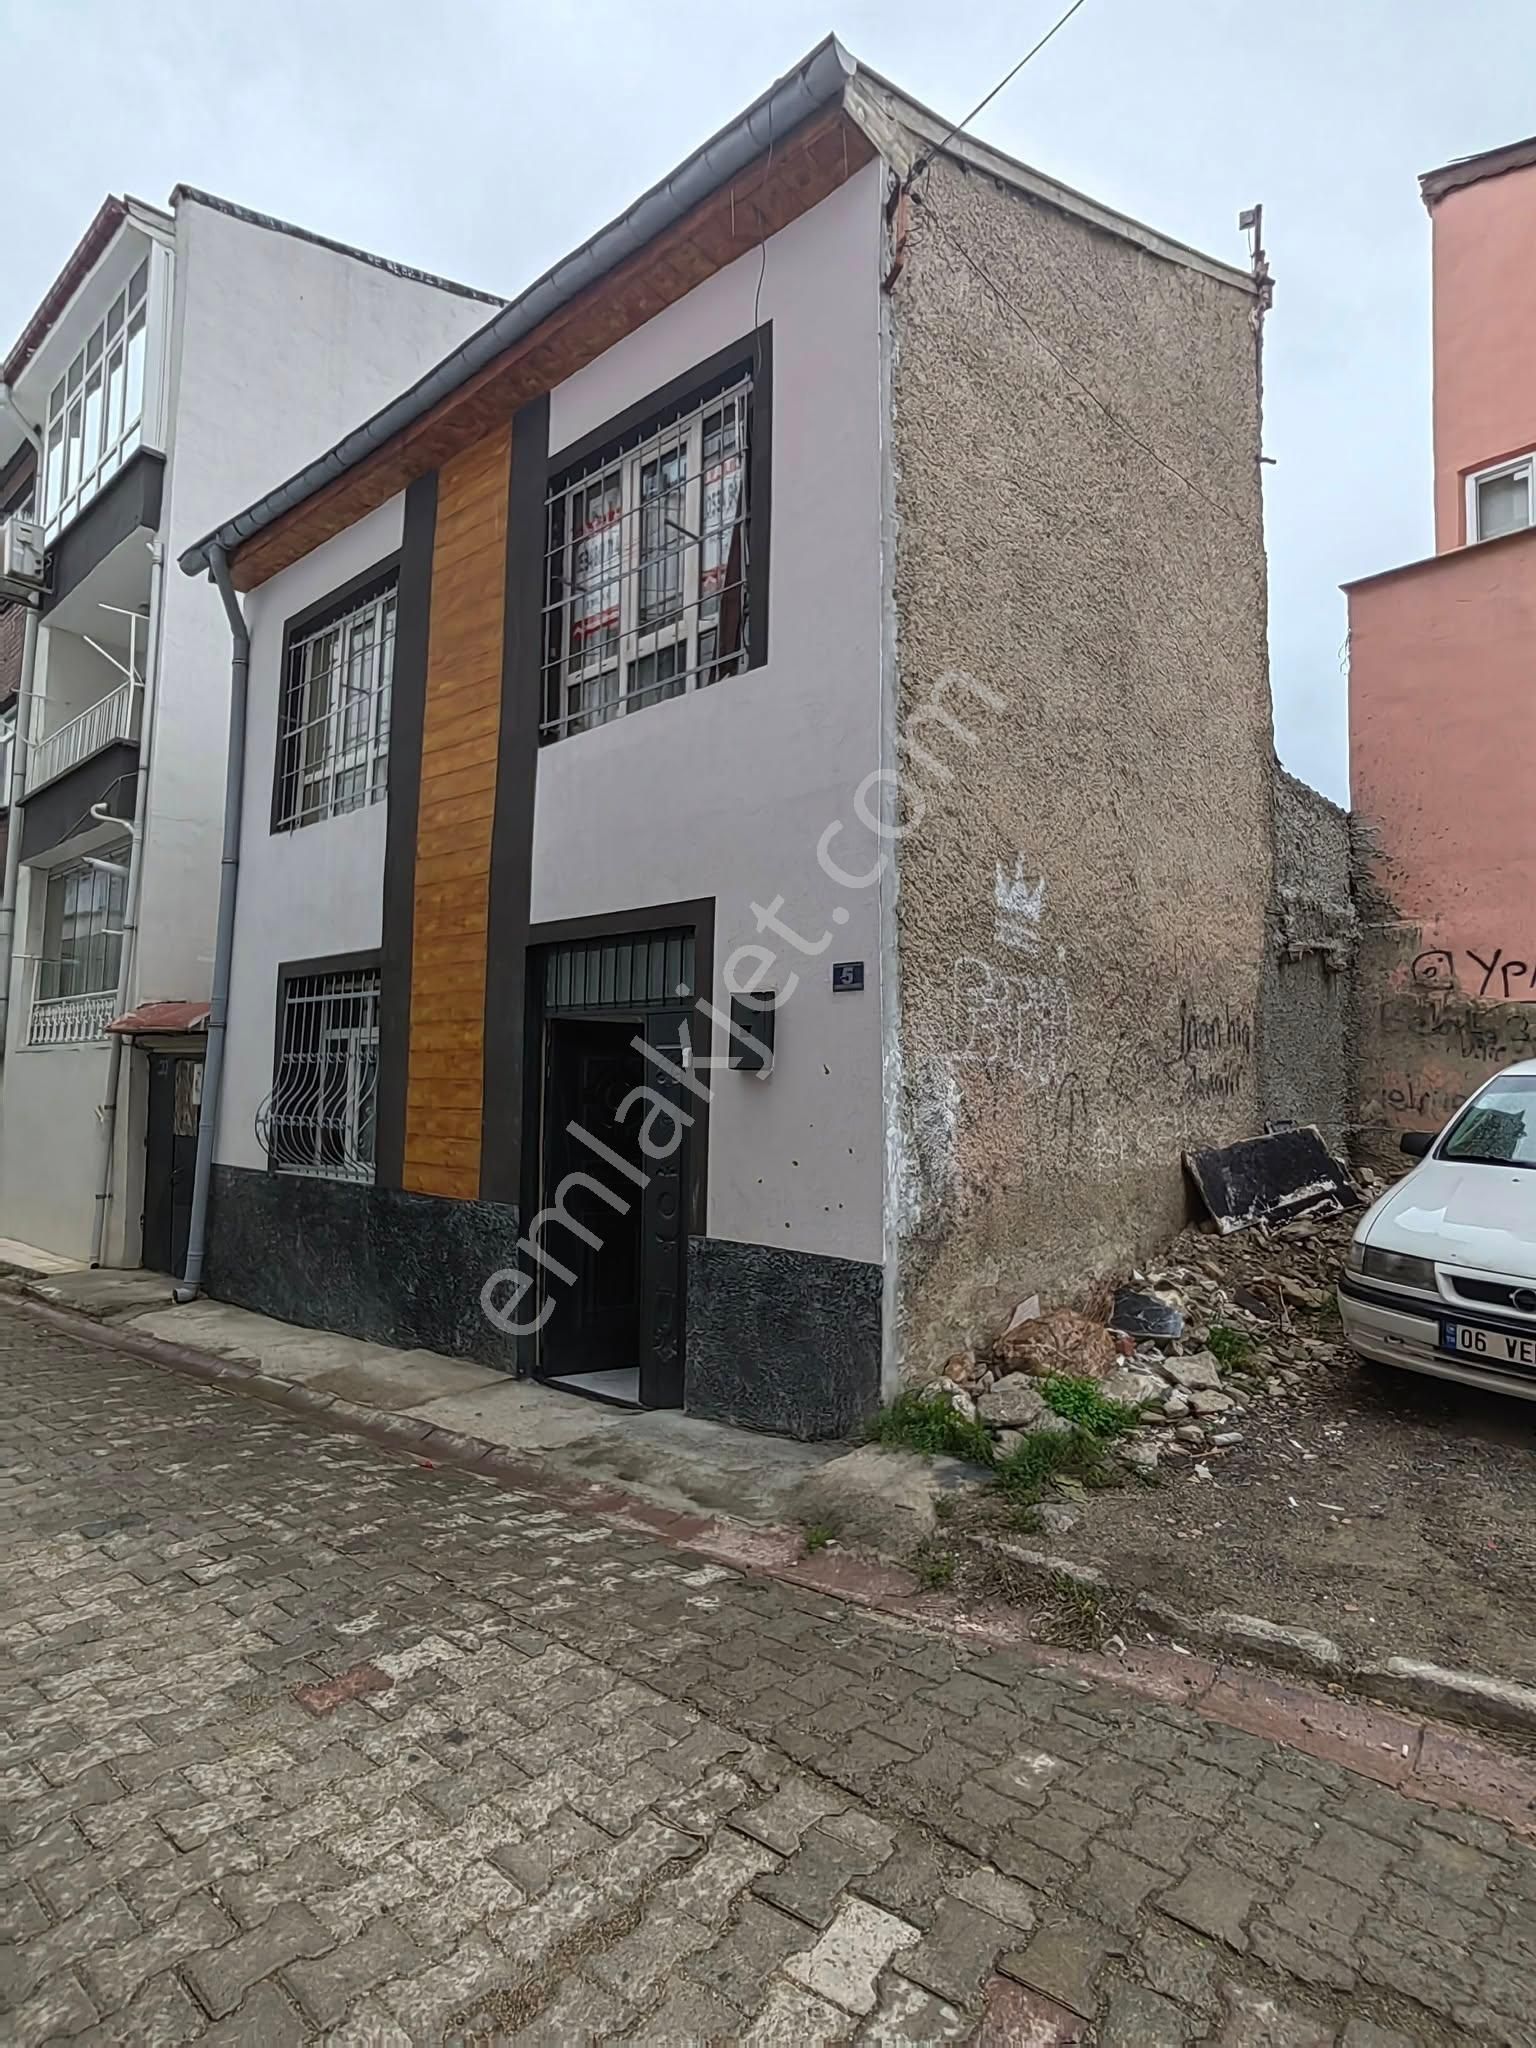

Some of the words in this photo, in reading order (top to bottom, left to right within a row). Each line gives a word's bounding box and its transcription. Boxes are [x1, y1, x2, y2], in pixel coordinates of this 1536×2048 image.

[840, 966, 854, 985] 5
[1461, 1329, 1487, 1352] 06
[1505, 1337, 1536, 1364] VE
